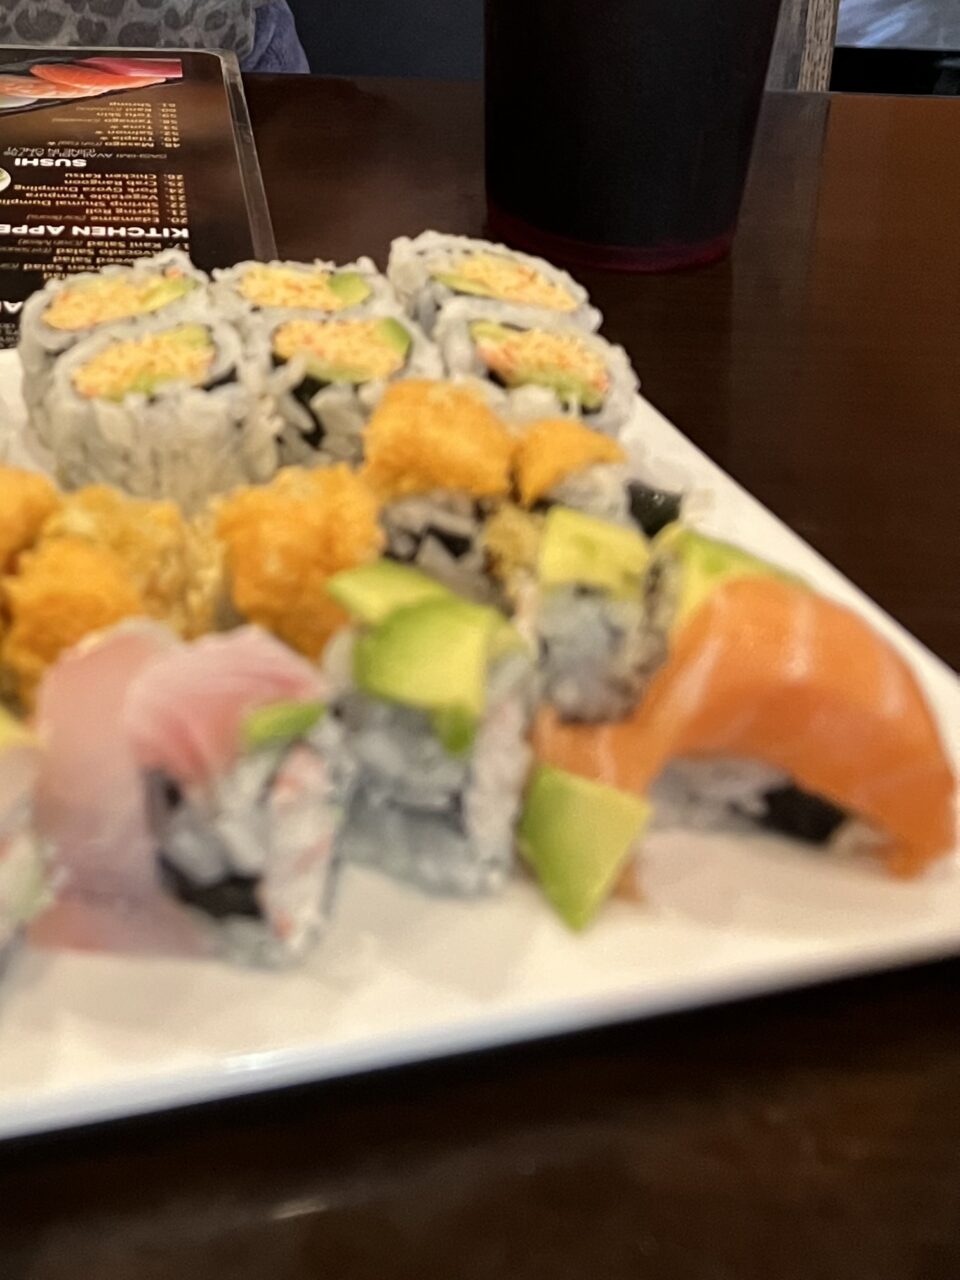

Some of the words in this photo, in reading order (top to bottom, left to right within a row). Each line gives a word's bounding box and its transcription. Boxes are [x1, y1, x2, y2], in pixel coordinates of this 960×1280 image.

[14, 158, 87, 168] SUSHI
[14, 184, 78, 192] Dumpling
[90, 192, 158, 200] Vegetable
[110, 200, 159, 208] Shrimp
[116, 208, 159, 216] Spring
[72, 226, 189, 238] KITCHEN
